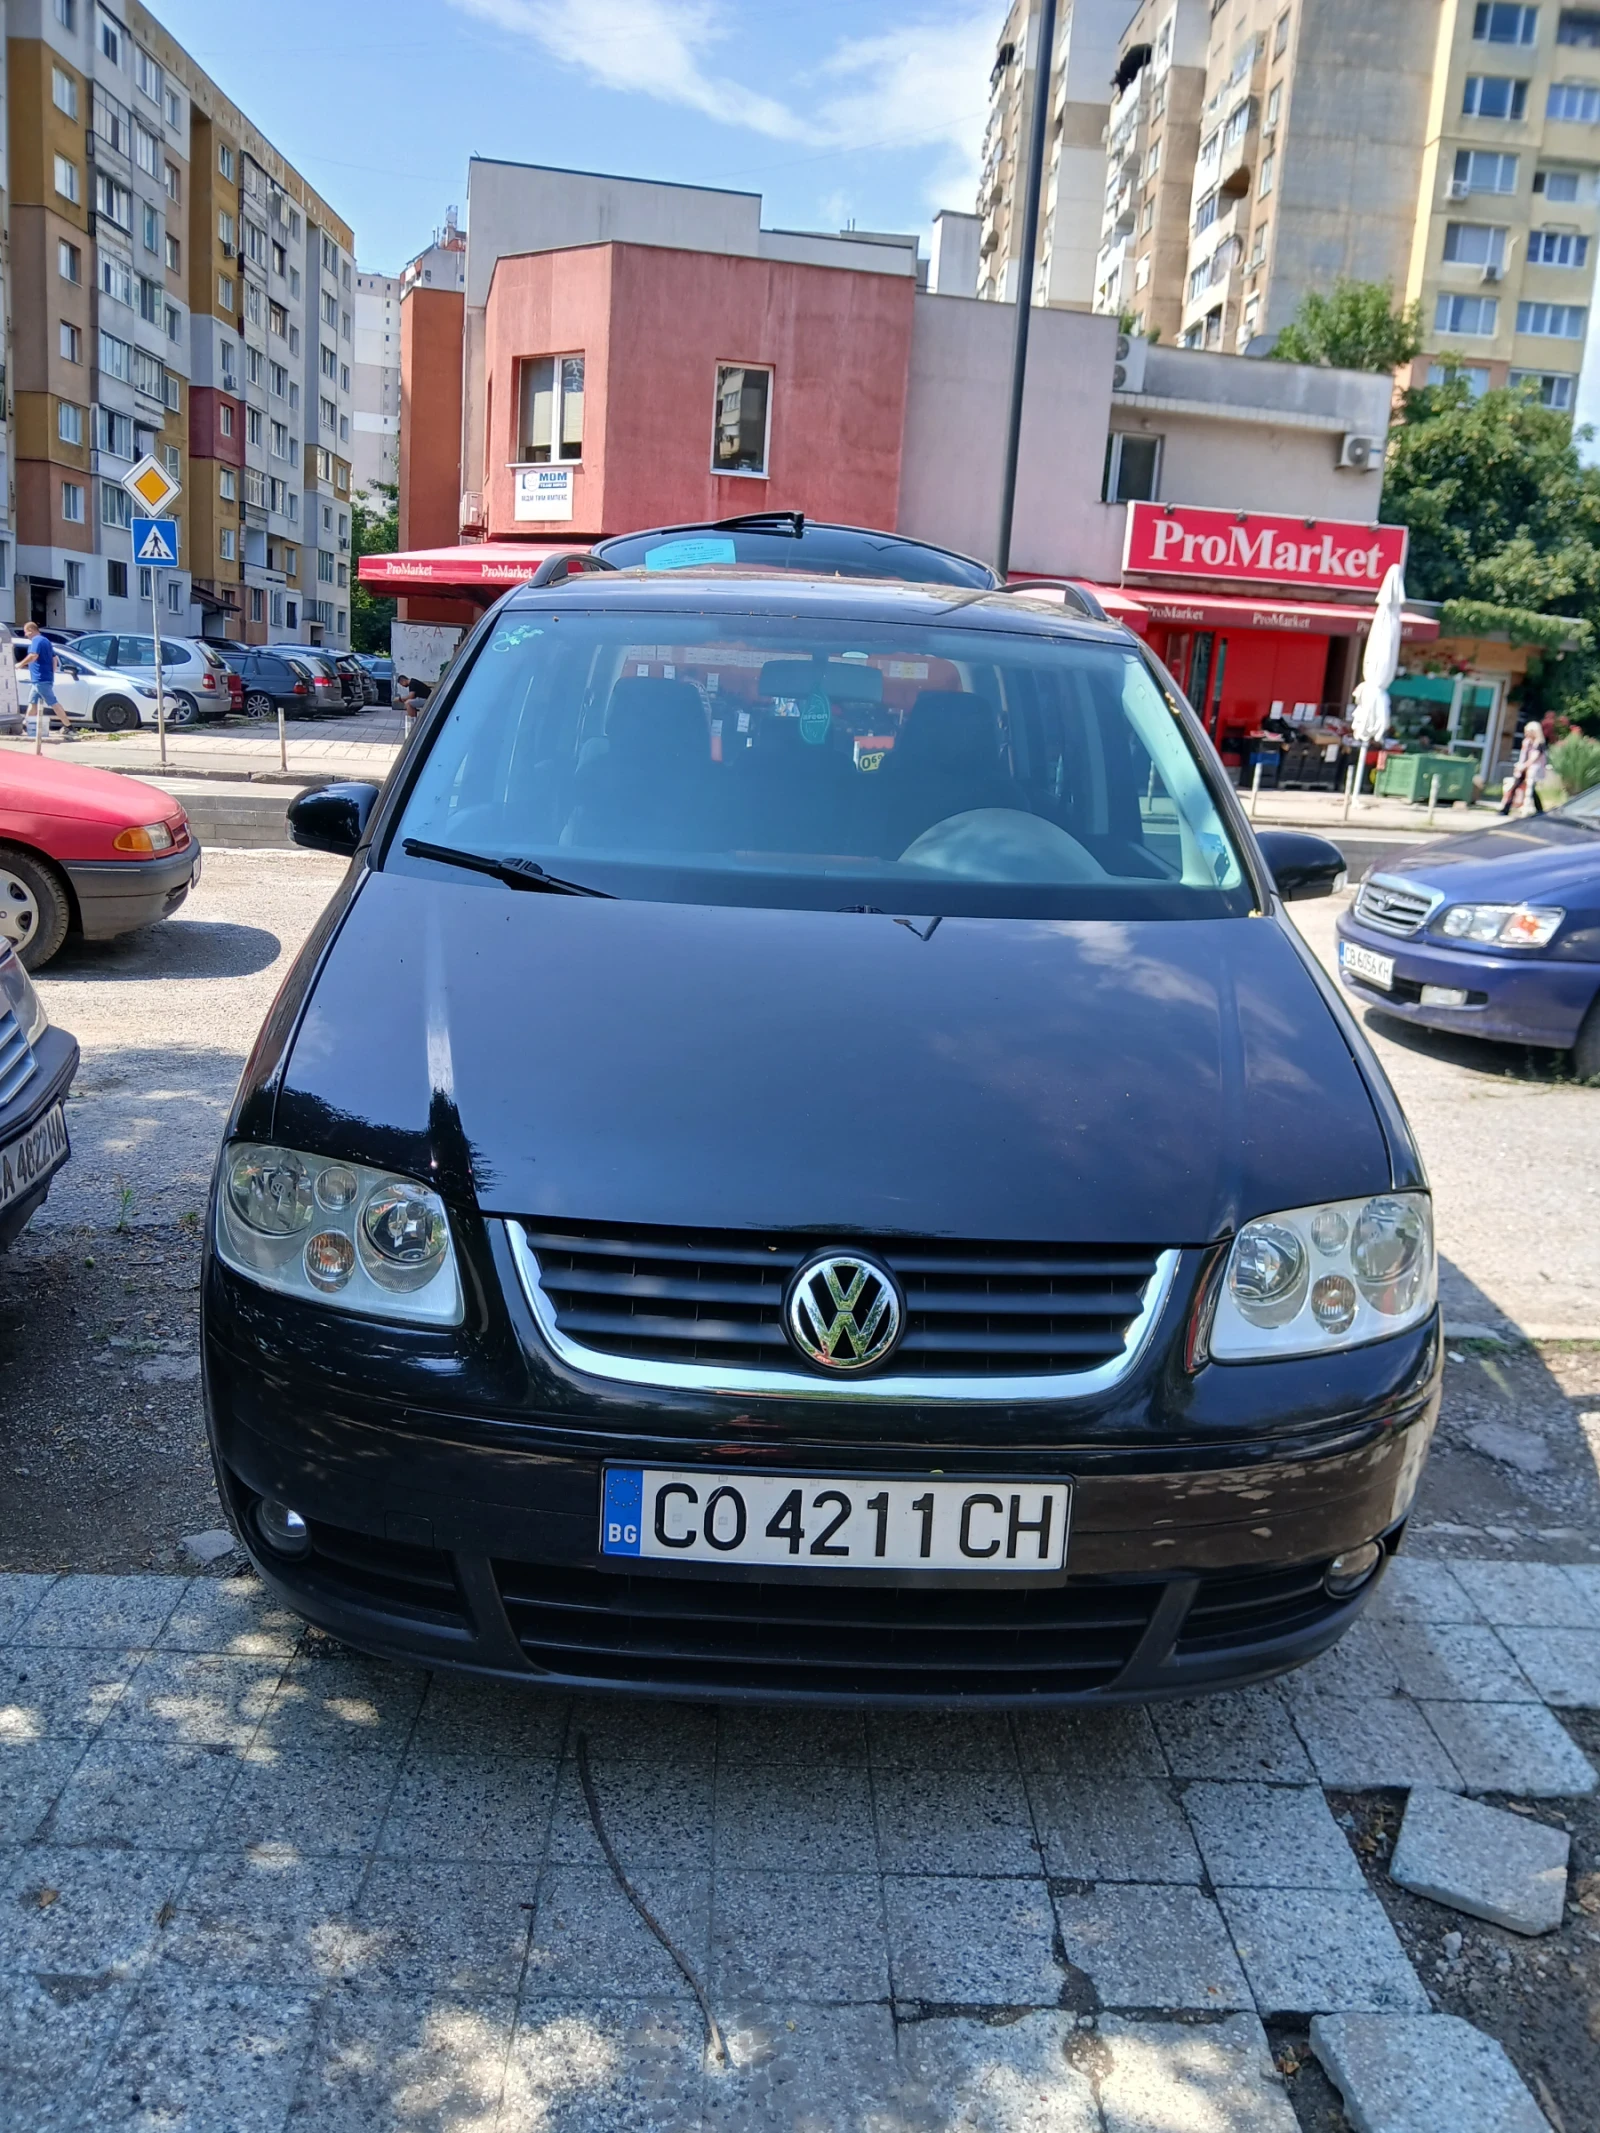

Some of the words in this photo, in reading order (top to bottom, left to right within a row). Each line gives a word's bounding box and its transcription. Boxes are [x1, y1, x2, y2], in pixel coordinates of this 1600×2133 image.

[539, 472, 567, 481] MDM
[1149, 519, 1384, 579] ProMarket
[386, 562, 432, 576] ProMarket
[481, 564, 533, 579] ProMarket
[1253, 613, 1310, 628] ProMarket
[765, 1489, 935, 1558] 4211
[959, 1493, 1053, 1558] CH
[608, 1523, 637, 1543] BG
